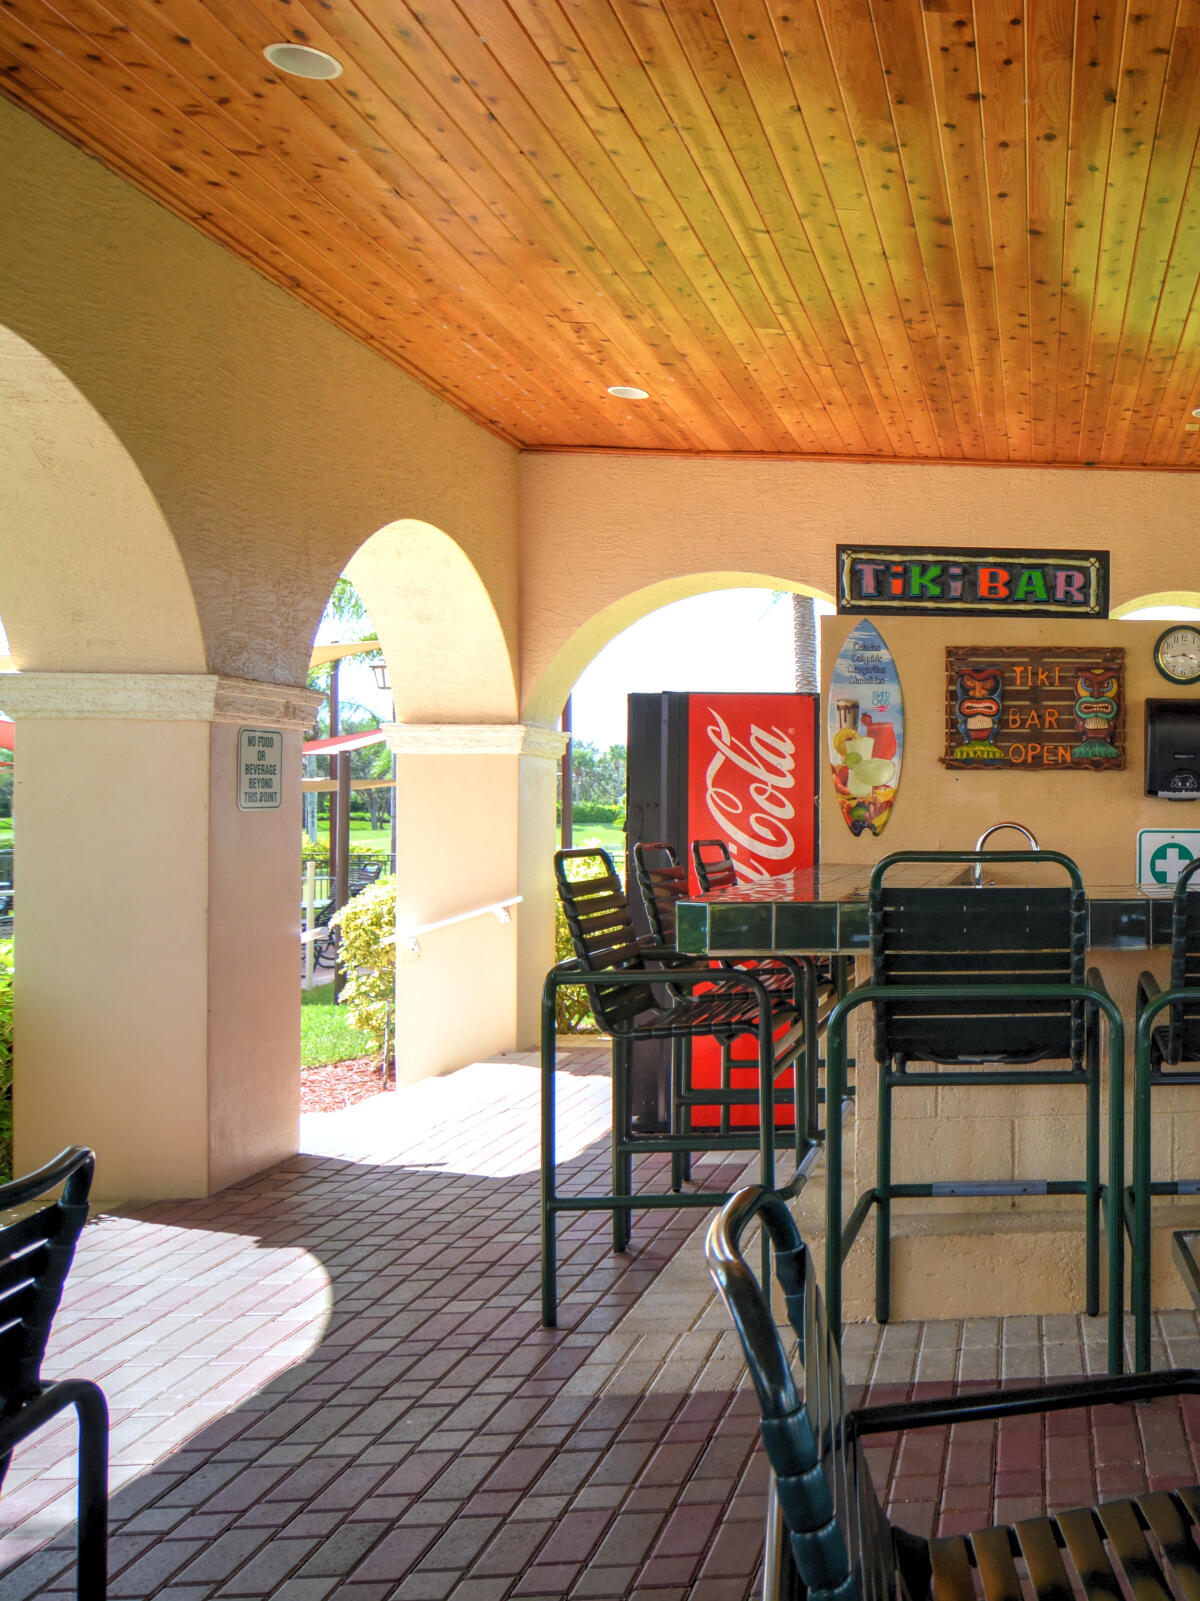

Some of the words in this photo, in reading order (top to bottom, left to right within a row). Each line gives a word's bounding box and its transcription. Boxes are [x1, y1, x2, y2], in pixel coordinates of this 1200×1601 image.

[976, 566, 1086, 603] BAR
[1009, 707, 1059, 729] BAR
[247, 735, 256, 747] NO
[258, 737, 274, 748] FOOD
[257, 750, 266, 762] OR
[1009, 743, 1072, 764] OPEN
[245, 764, 277, 775] BEVERAGE
[249, 778, 273, 789] BEYOND
[244, 792, 258, 803] THIS
[259, 791, 278, 803] POINT
[706, 706, 796, 881] -Cola
